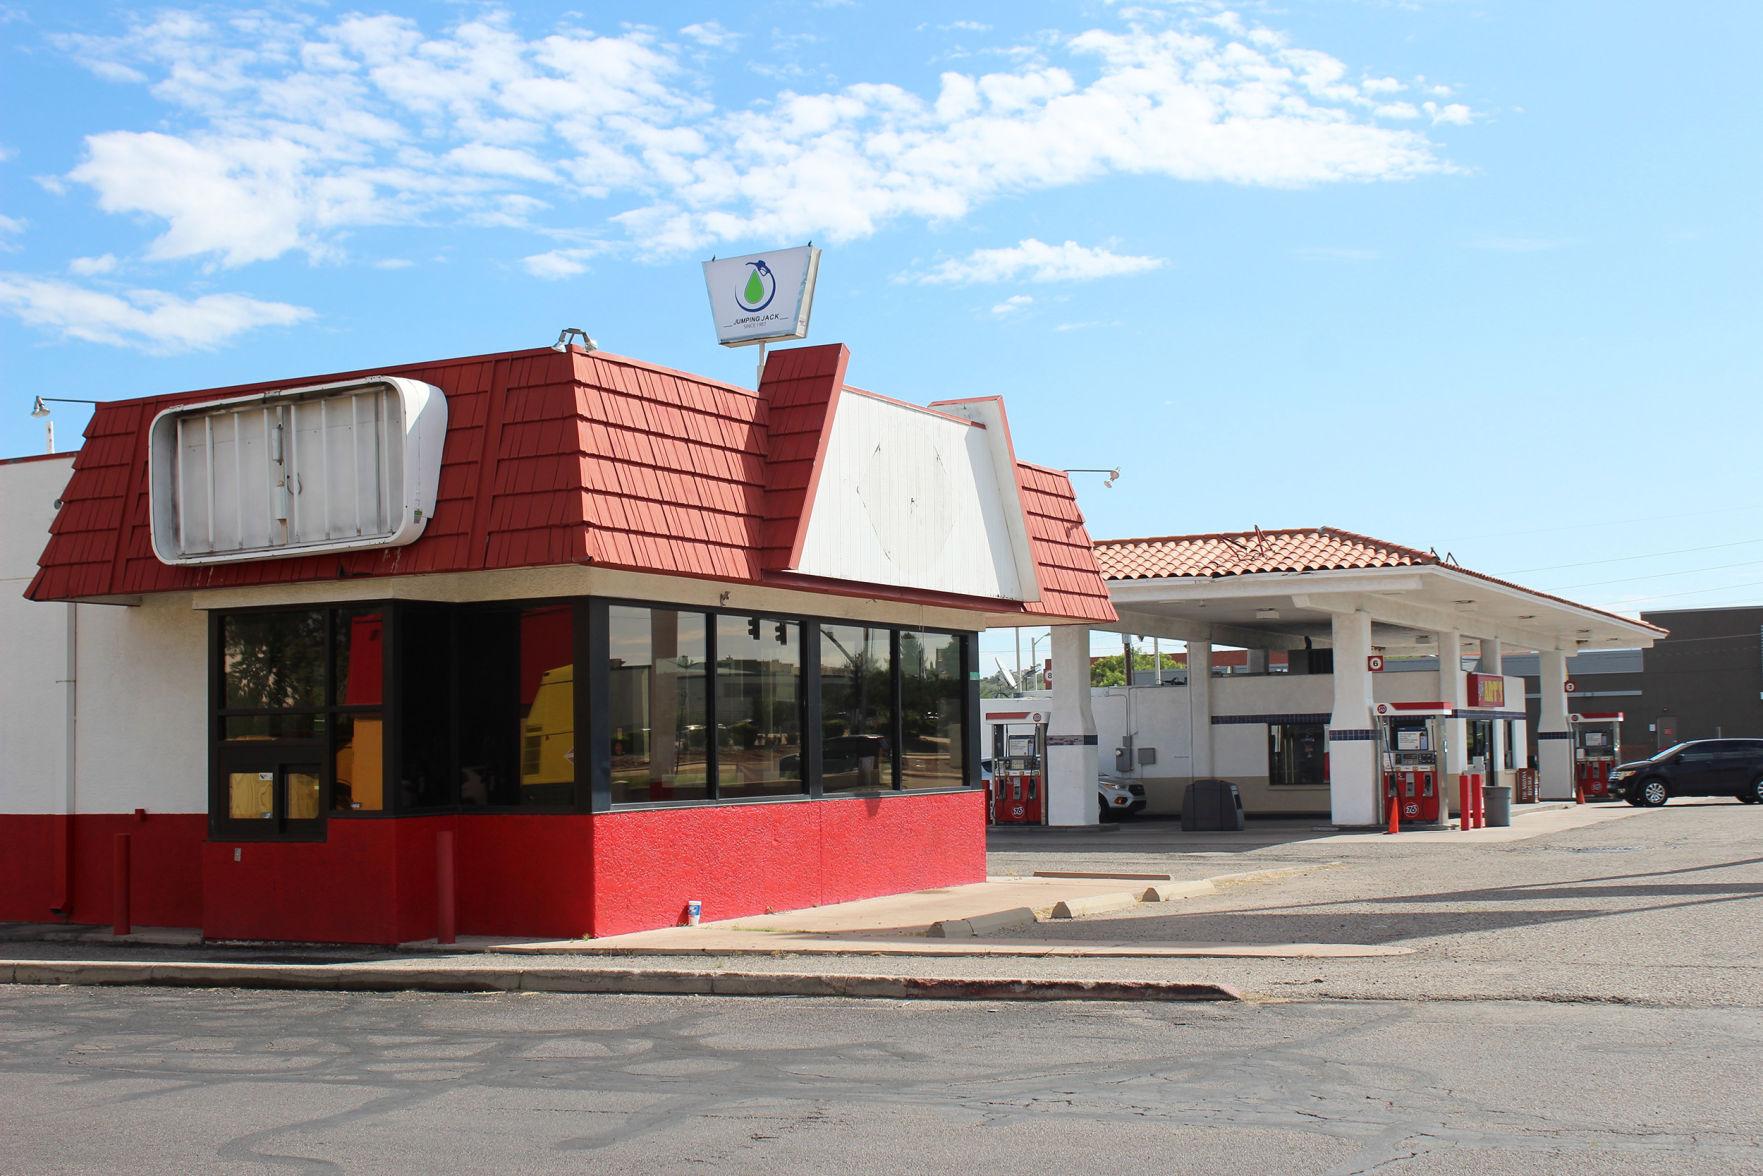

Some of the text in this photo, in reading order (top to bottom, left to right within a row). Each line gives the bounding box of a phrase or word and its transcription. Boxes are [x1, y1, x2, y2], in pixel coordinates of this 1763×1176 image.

[733, 313, 779, 325] JUMPING JACK
[1373, 659, 1379, 667] 6
